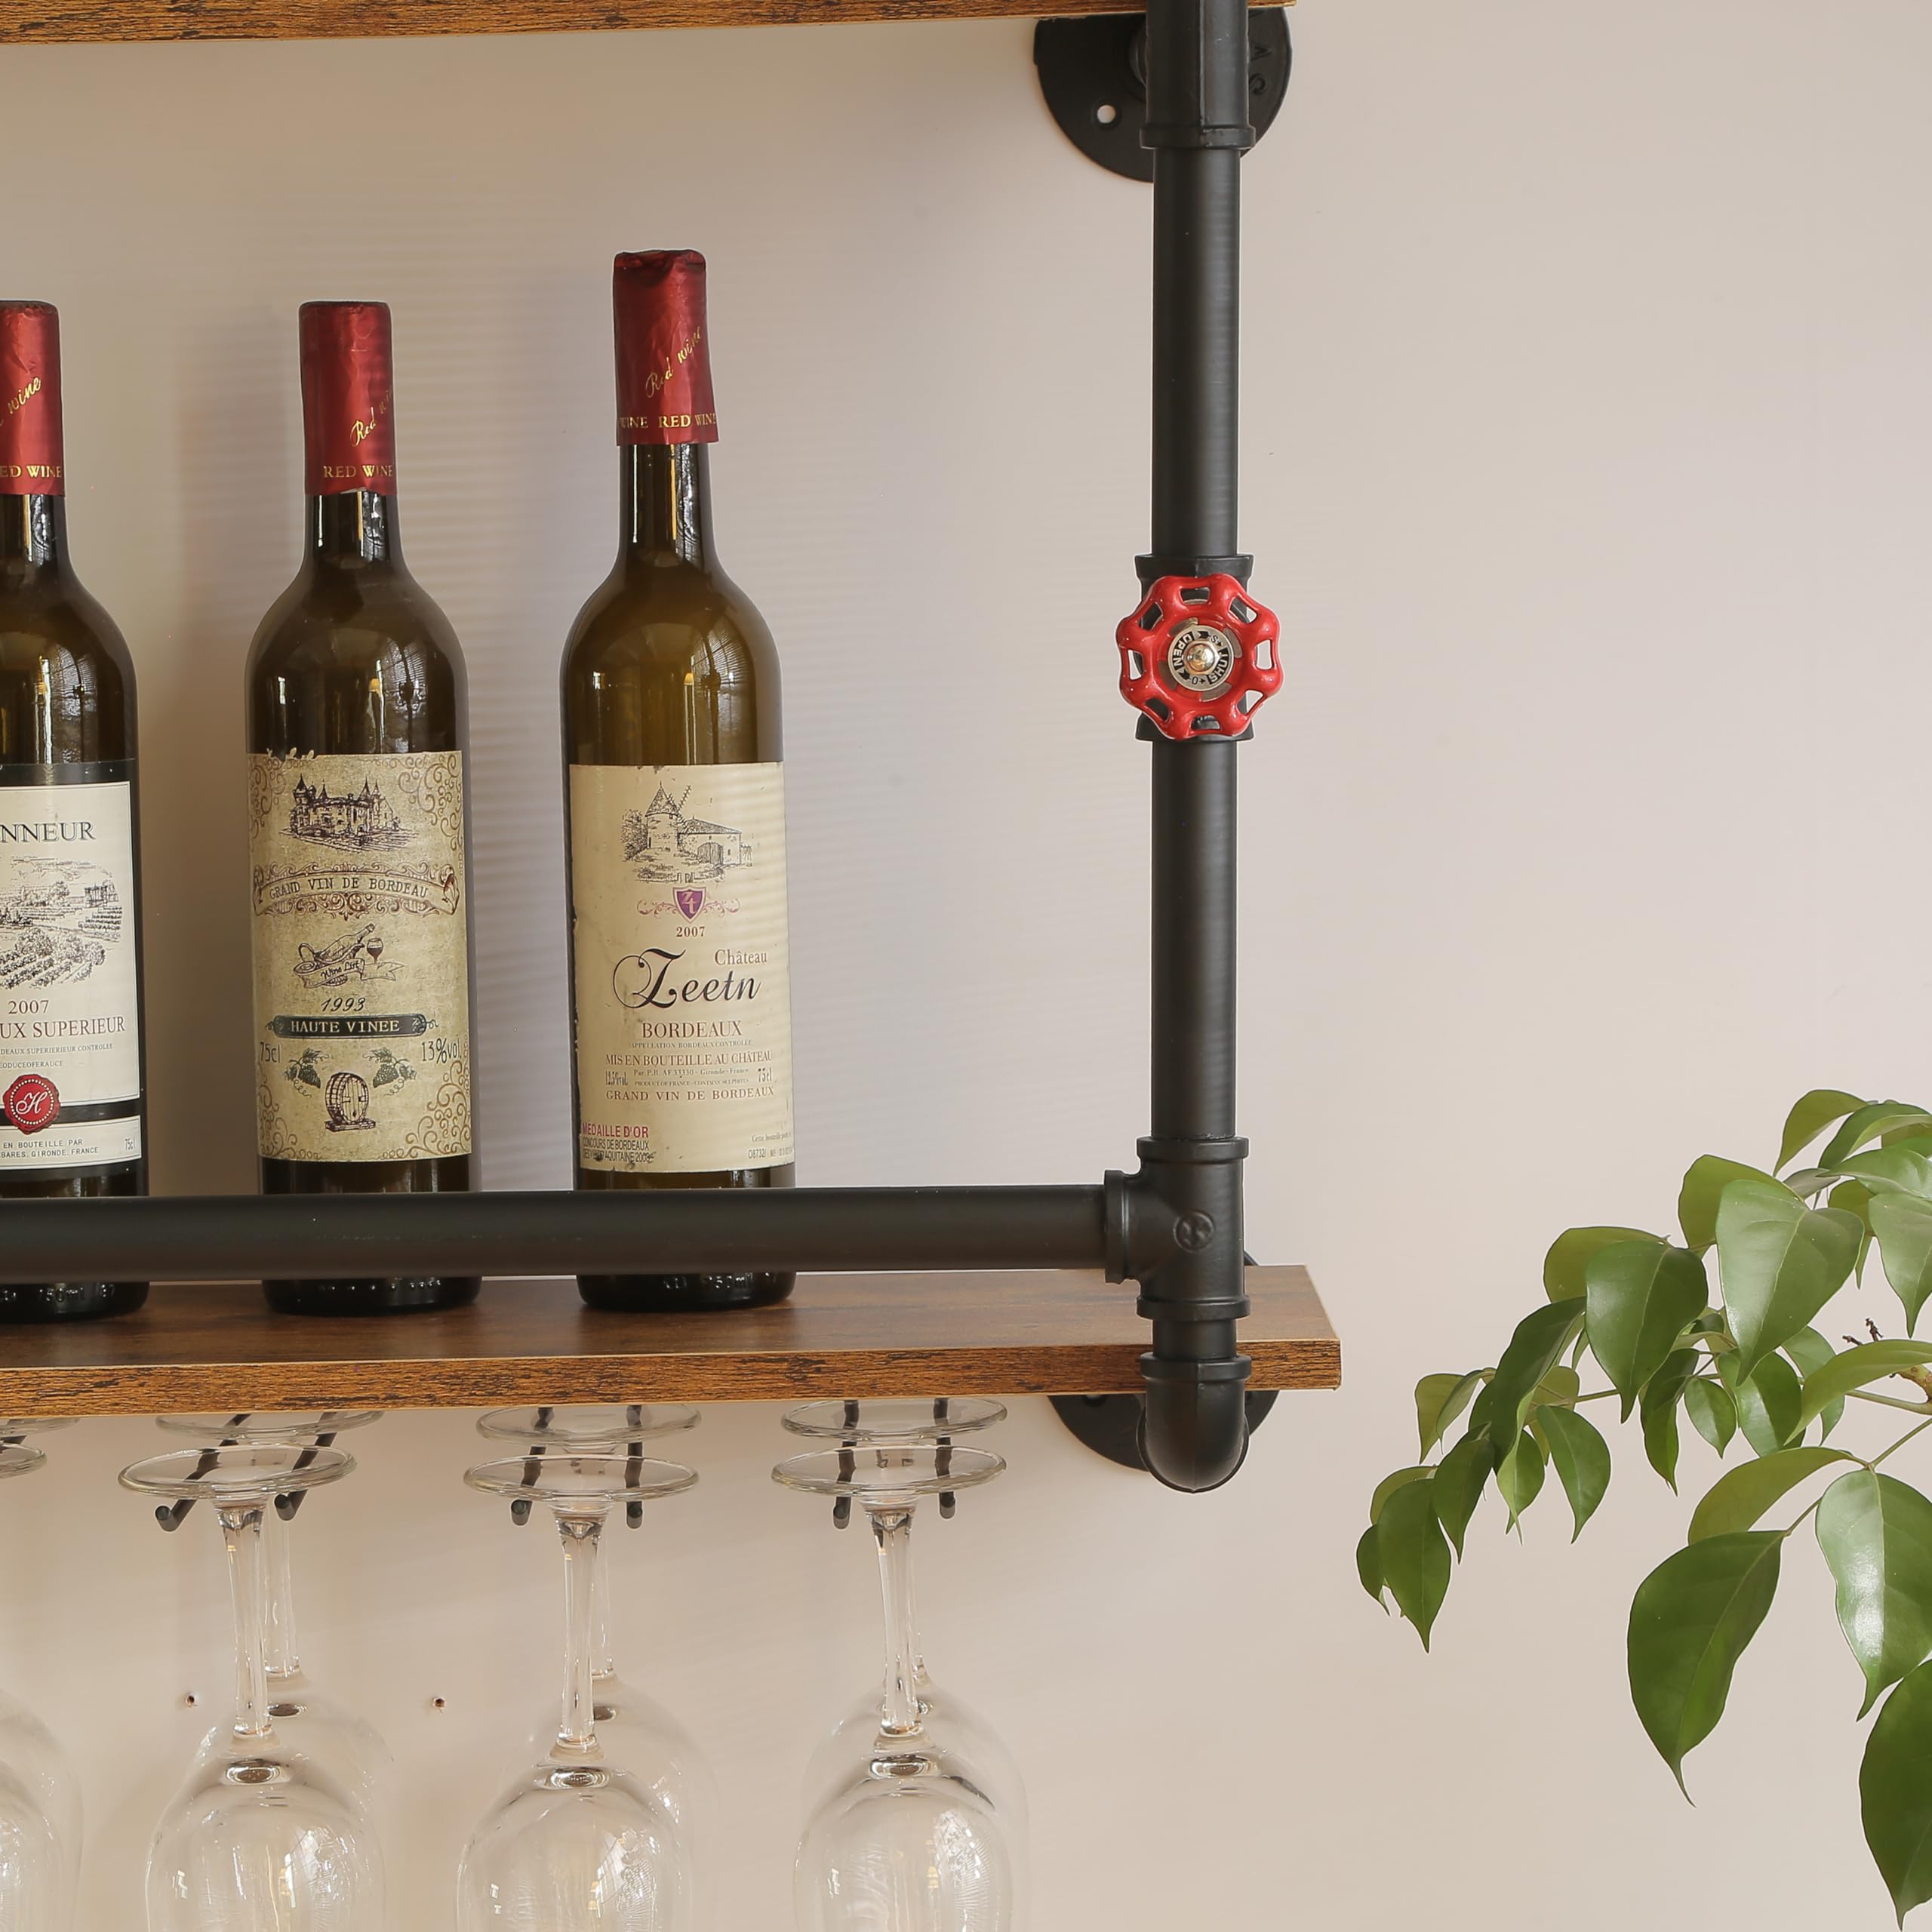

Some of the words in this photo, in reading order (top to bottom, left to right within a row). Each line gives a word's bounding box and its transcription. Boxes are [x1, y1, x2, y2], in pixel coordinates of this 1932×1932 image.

[645, 357, 673, 398] Red
[678, 326, 701, 364] wine
[8, 377, 42, 414] wine
[350, 407, 376, 447] Red
[620, 417, 648, 428] WINE
[658, 415, 691, 427] RED
[26, 465, 62, 478] WINE
[323, 466, 357, 478] RED
[362, 465, 393, 478] WINE
[1173, 633, 1194, 668] OPEN
[1208, 652, 1229, 683] SHUT
[269, 881, 300, 900] GRAND
[307, 878, 334, 891] VIN
[343, 877, 359, 888] DE
[369, 878, 429, 898] BORDEAU
[675, 926, 706, 938] 2007
[714, 949, 768, 965] Château
[8, 1000, 49, 1014] 2007
[321, 997, 365, 1012] 1993
[0, 1023, 26, 1038] UX
[32, 1016, 125, 1038] SUPERIEUR
[291, 1020, 340, 1033] HAUTE
[346, 1020, 400, 1033] VINEE
[642, 1020, 743, 1039] BORDEAUX
[26, 1046, 76, 1054] SUPERIERIEUR
[260, 1041, 281, 1063] 75cl
[678, 1041, 715, 1049] BORDEAUX
[606, 1054, 623, 1066] MIS
[626, 1055, 640, 1066] EN
[715, 1053, 730, 1065] AU
[606, 1090, 649, 1101] GRAND
[657, 1091, 679, 1100] VIN
[688, 1091, 706, 1100] DE
[712, 1087, 774, 1100] BORDEAUX
[623, 1126, 648, 1138] D'OR
[18, 1140, 63, 1148] BOUTEILLE
[71, 1147, 99, 1155] FRANCE
[615, 1140, 649, 1151] BORDEAUX
